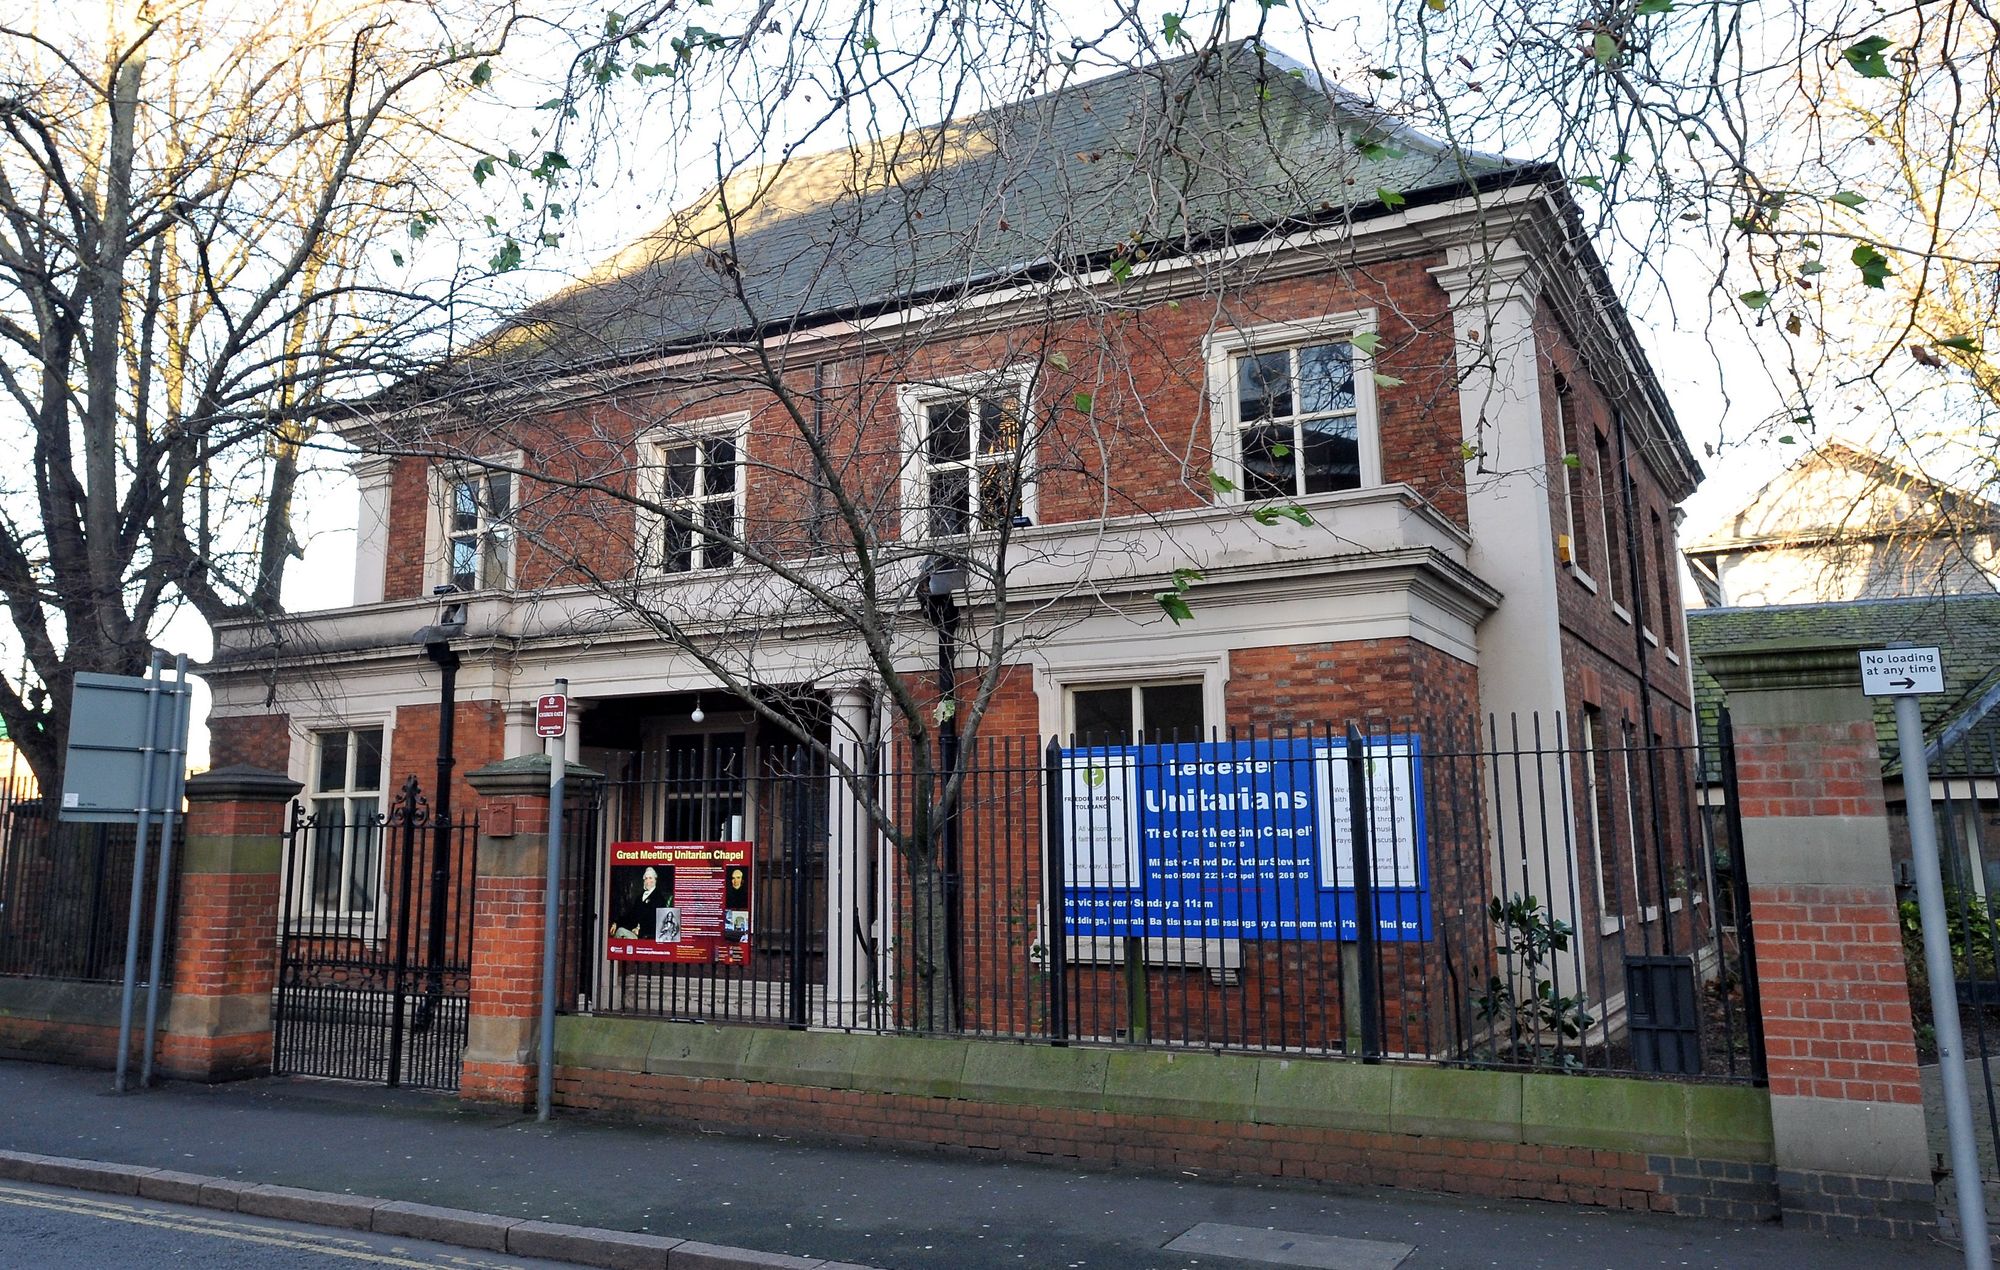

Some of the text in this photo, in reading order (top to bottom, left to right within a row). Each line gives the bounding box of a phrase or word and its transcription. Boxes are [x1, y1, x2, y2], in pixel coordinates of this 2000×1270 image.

[1866, 653, 1934, 664] No loading
[1866, 664, 1937, 676] at any time
[1146, 787, 1308, 812] Unitarians
[1377, 815, 1405, 823] throgh
[1228, 840, 1246, 848] 178
[616, 850, 744, 862] Great Meeting Unitarian Chapel
[1149, 858, 1188, 867] Miistr
[1222, 858, 1236, 866] Dr.
[1064, 898, 1105, 907] Sevices
[1149, 917, 1192, 926] Batisms
[1270, 919, 1333, 930] aranemnt
[1376, 920, 1418, 929] initer
